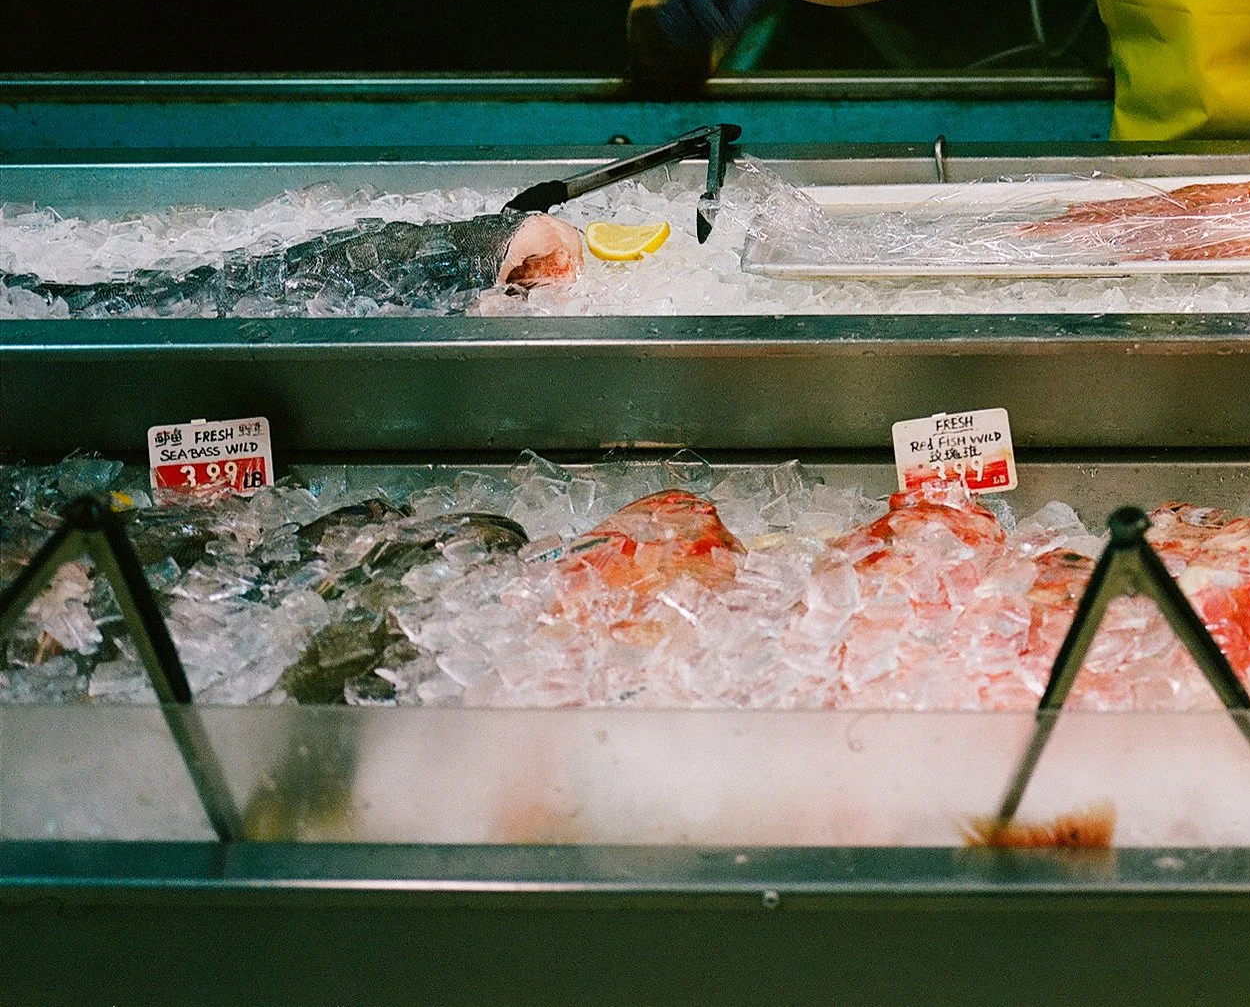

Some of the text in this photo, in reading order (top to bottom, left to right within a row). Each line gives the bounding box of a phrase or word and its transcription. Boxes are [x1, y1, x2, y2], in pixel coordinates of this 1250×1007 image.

[936, 415, 974, 432] FRESH
[195, 428, 234, 445] FRESH
[970, 431, 1002, 444] WILD
[225, 442, 259, 455] WILD
[243, 471, 264, 489] LB
[992, 475, 1006, 485] LB
